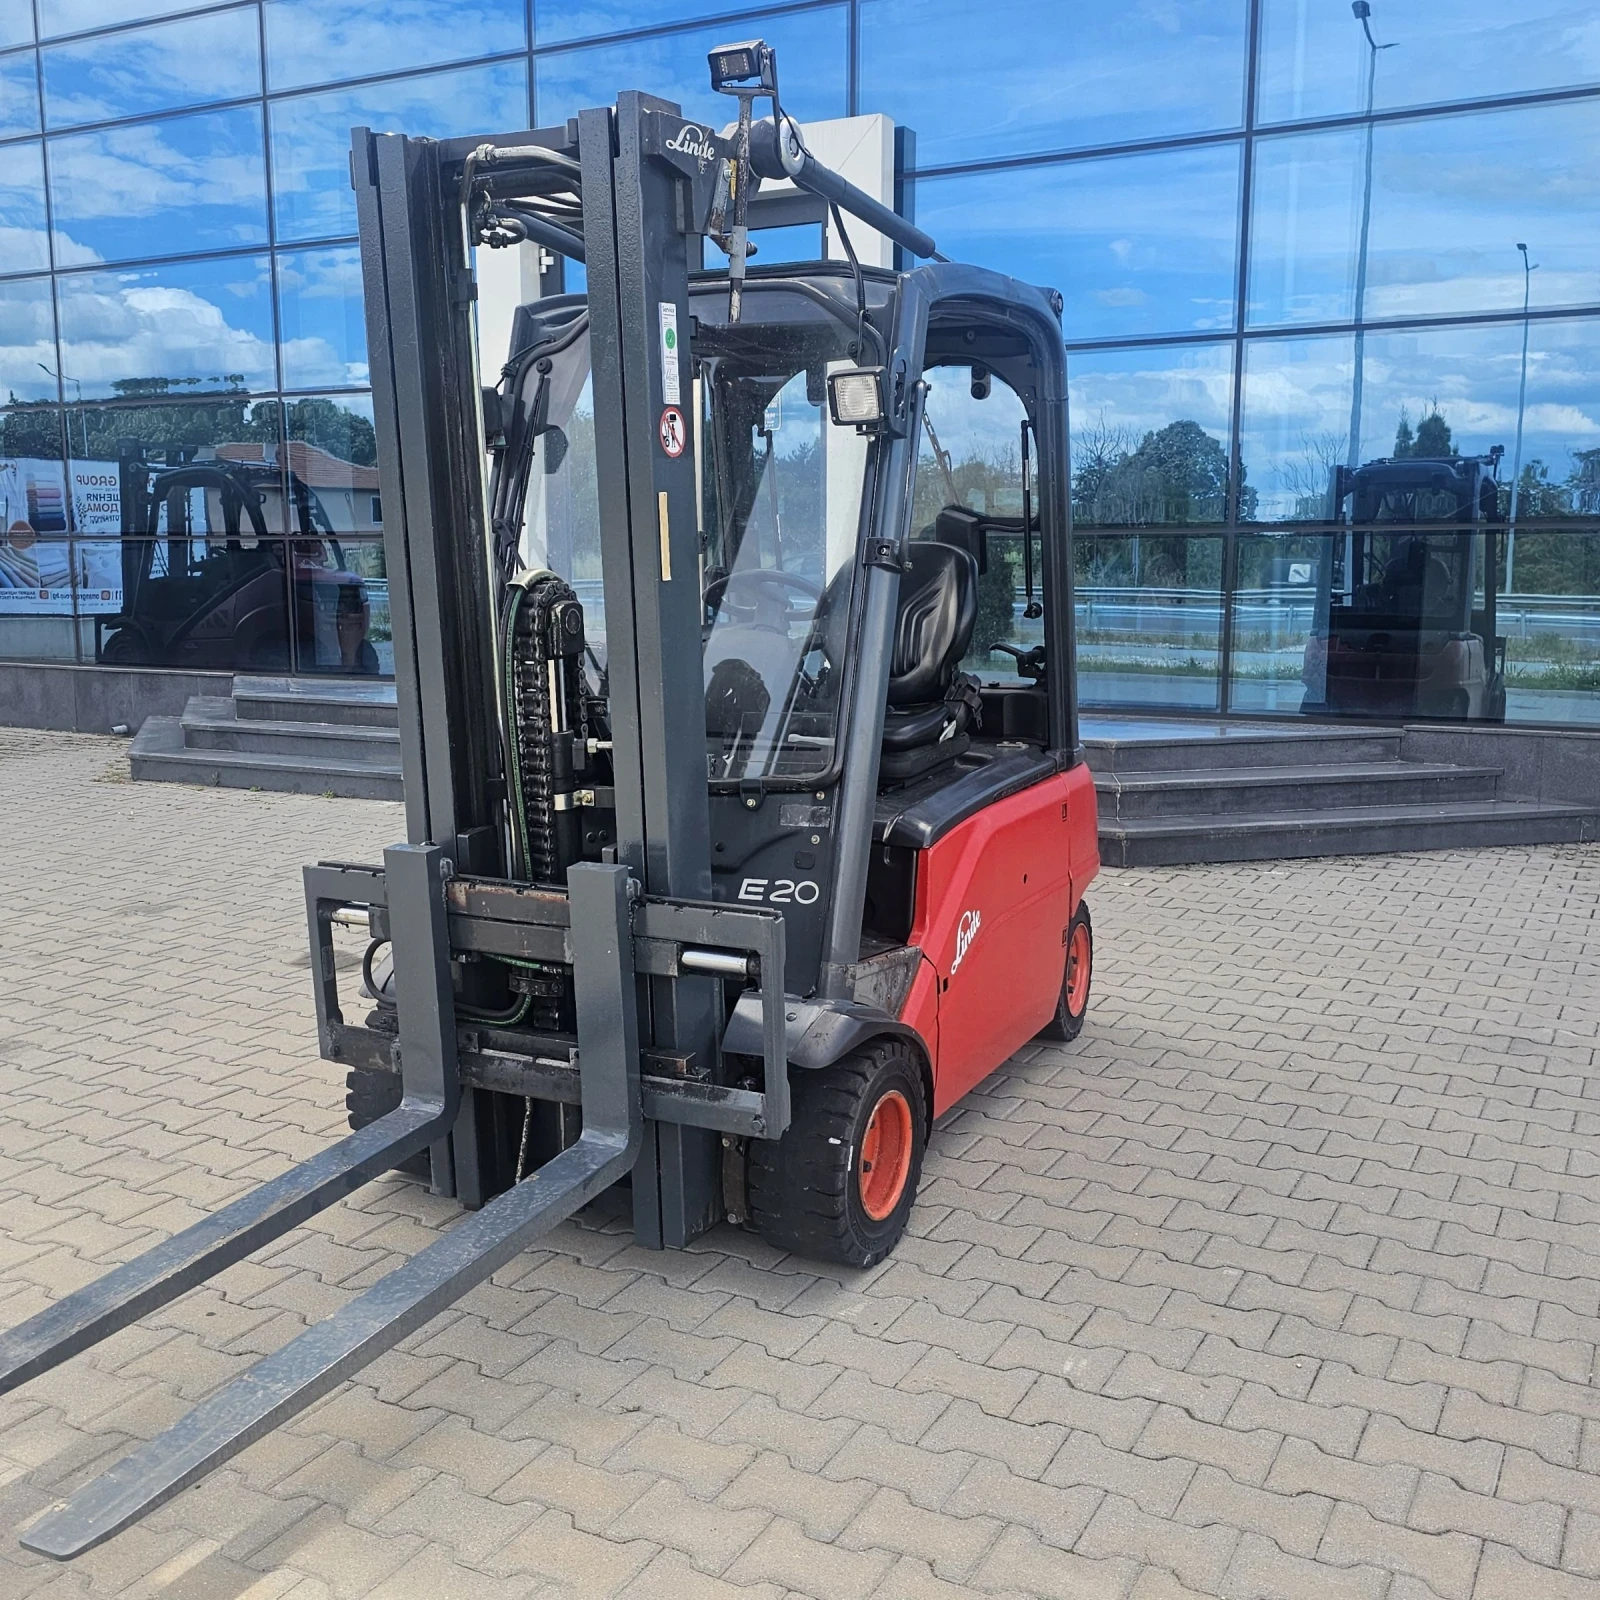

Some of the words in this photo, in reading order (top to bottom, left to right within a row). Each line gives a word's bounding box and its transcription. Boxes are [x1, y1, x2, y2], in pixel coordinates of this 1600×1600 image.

[666, 124, 715, 161] Linde
[738, 878, 819, 904] E20
[951, 910, 981, 975] Linde
